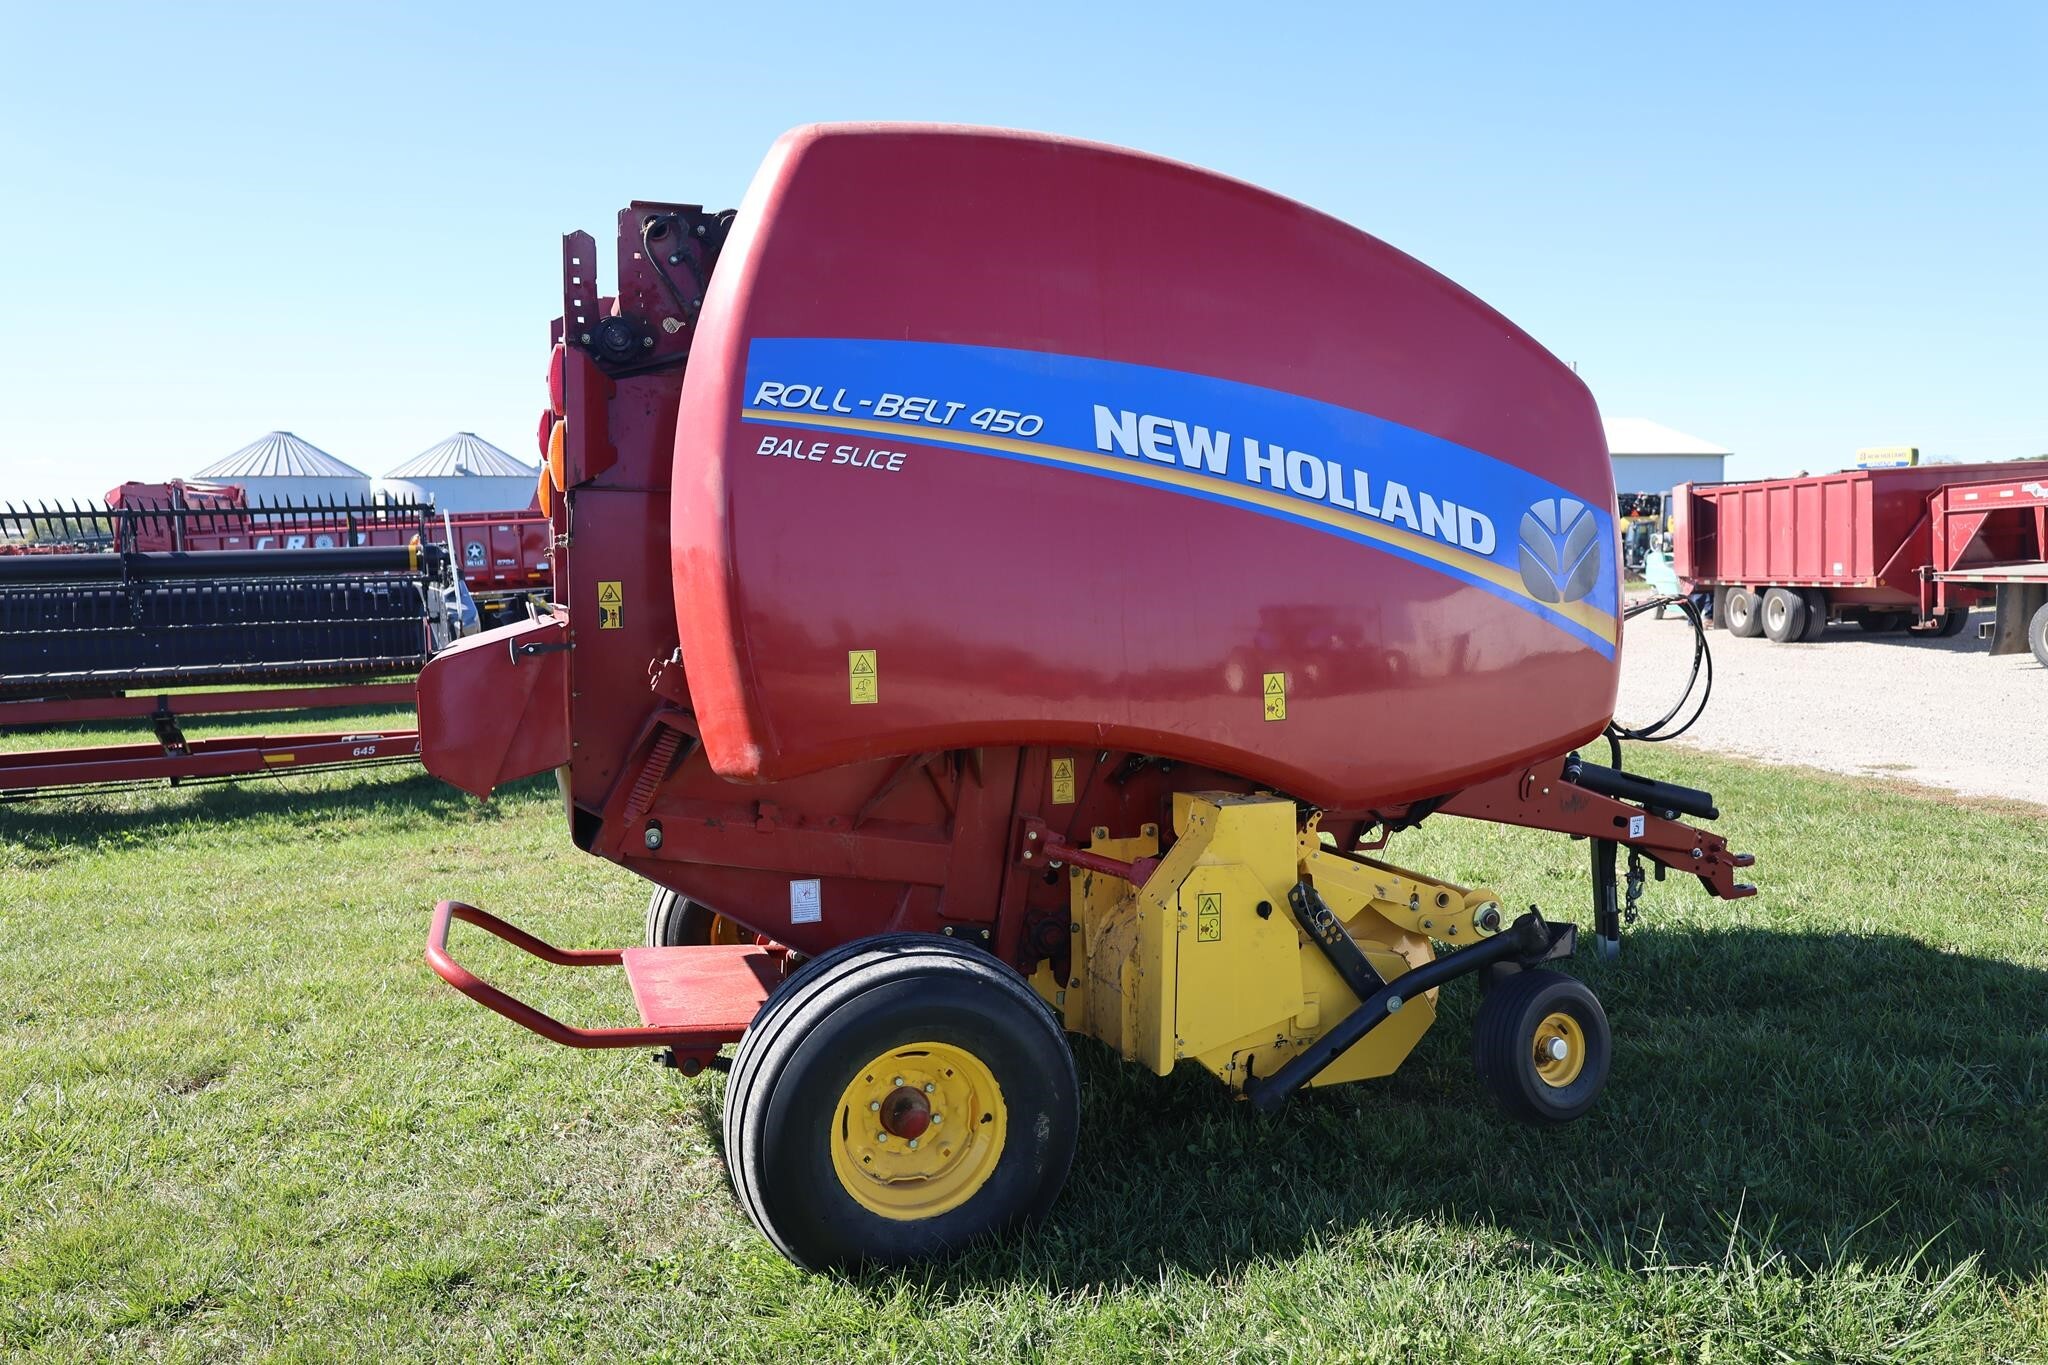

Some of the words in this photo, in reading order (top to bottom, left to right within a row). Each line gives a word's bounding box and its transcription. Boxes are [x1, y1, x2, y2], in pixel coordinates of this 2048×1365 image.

[970, 407, 1044, 437] 450
[756, 436, 829, 462] BALE
[832, 444, 907, 472] SLICE
[1093, 404, 1231, 475] NEW
[1243, 437, 1497, 556] HOLLAND
[353, 745, 376, 757] 645
